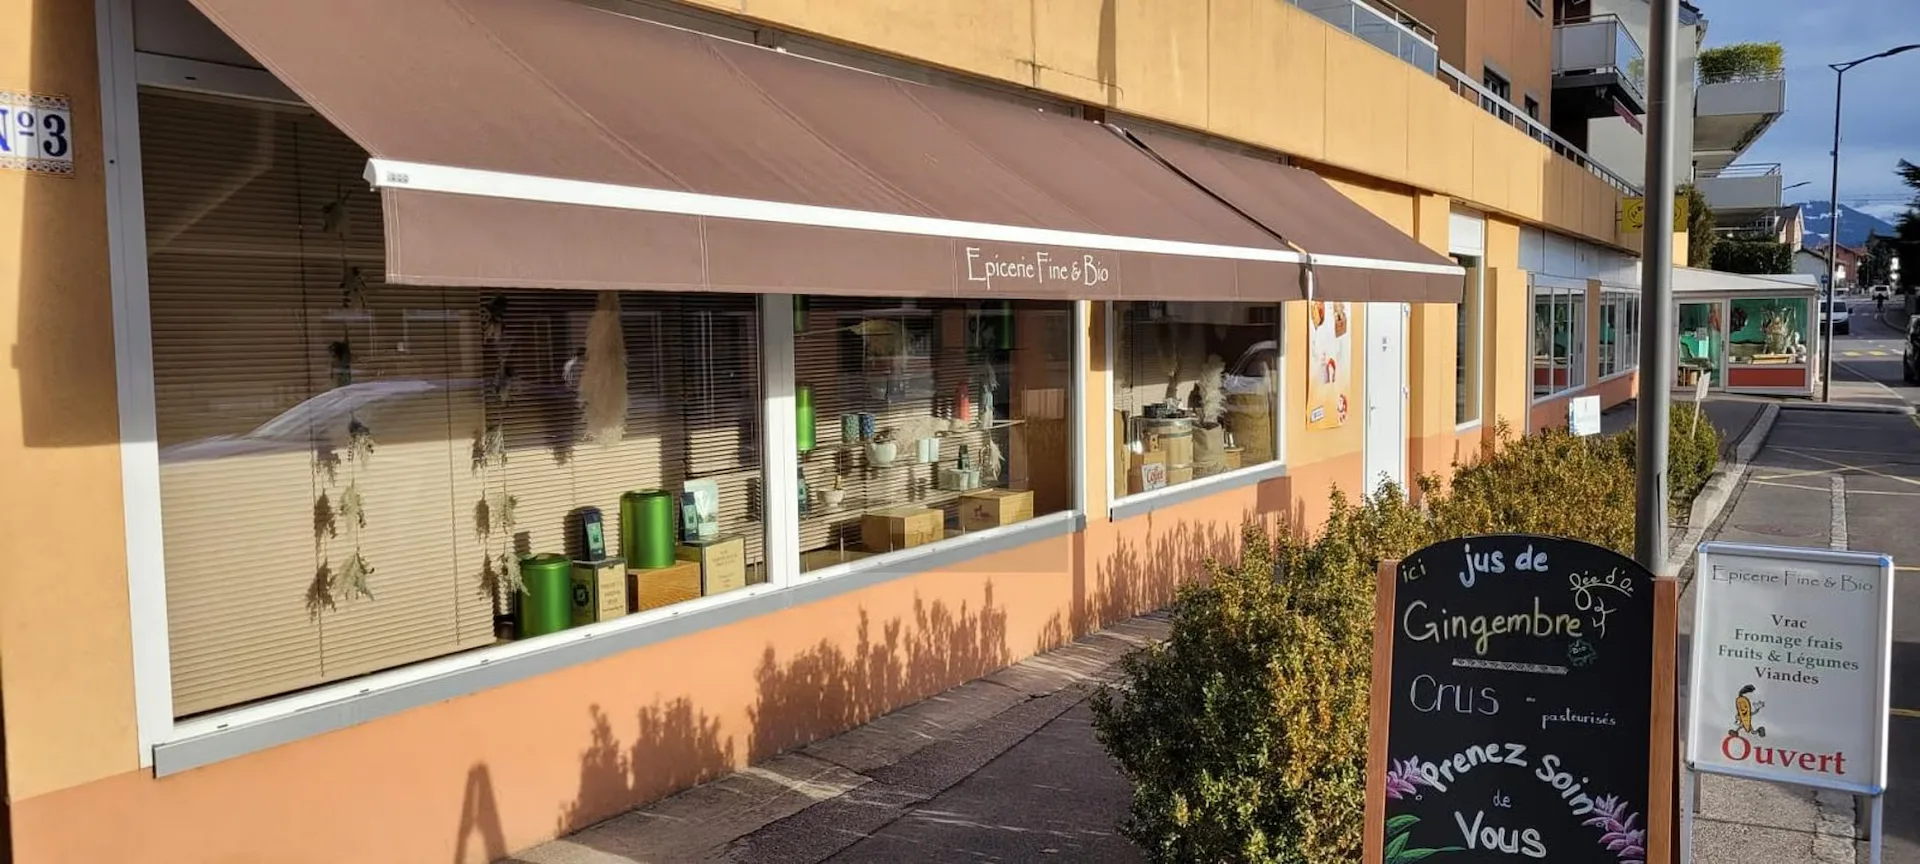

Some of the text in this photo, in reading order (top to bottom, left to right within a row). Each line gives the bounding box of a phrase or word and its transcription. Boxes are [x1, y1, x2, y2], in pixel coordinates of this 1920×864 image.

[966, 247, 1109, 291] Epicerie Fine & Bio
[1401, 558, 1427, 583] ici
[1459, 543, 1549, 588] jus de
[1712, 565, 1873, 592] Epicerie Fine & Bio
[1403, 596, 1583, 656] Gingembre
[1771, 614, 1807, 629] Vrac
[1735, 628, 1843, 651] Fromage frais
[1718, 645, 1860, 671] Fruits & Légumes
[1755, 666, 1820, 685] Viandes
[1410, 674, 1500, 716] Crus
[1542, 707, 1617, 730] pasteurisés
[1722, 735, 1847, 775] Ouvert
[1492, 789, 1512, 808] de
[1454, 810, 1547, 858] Vous
